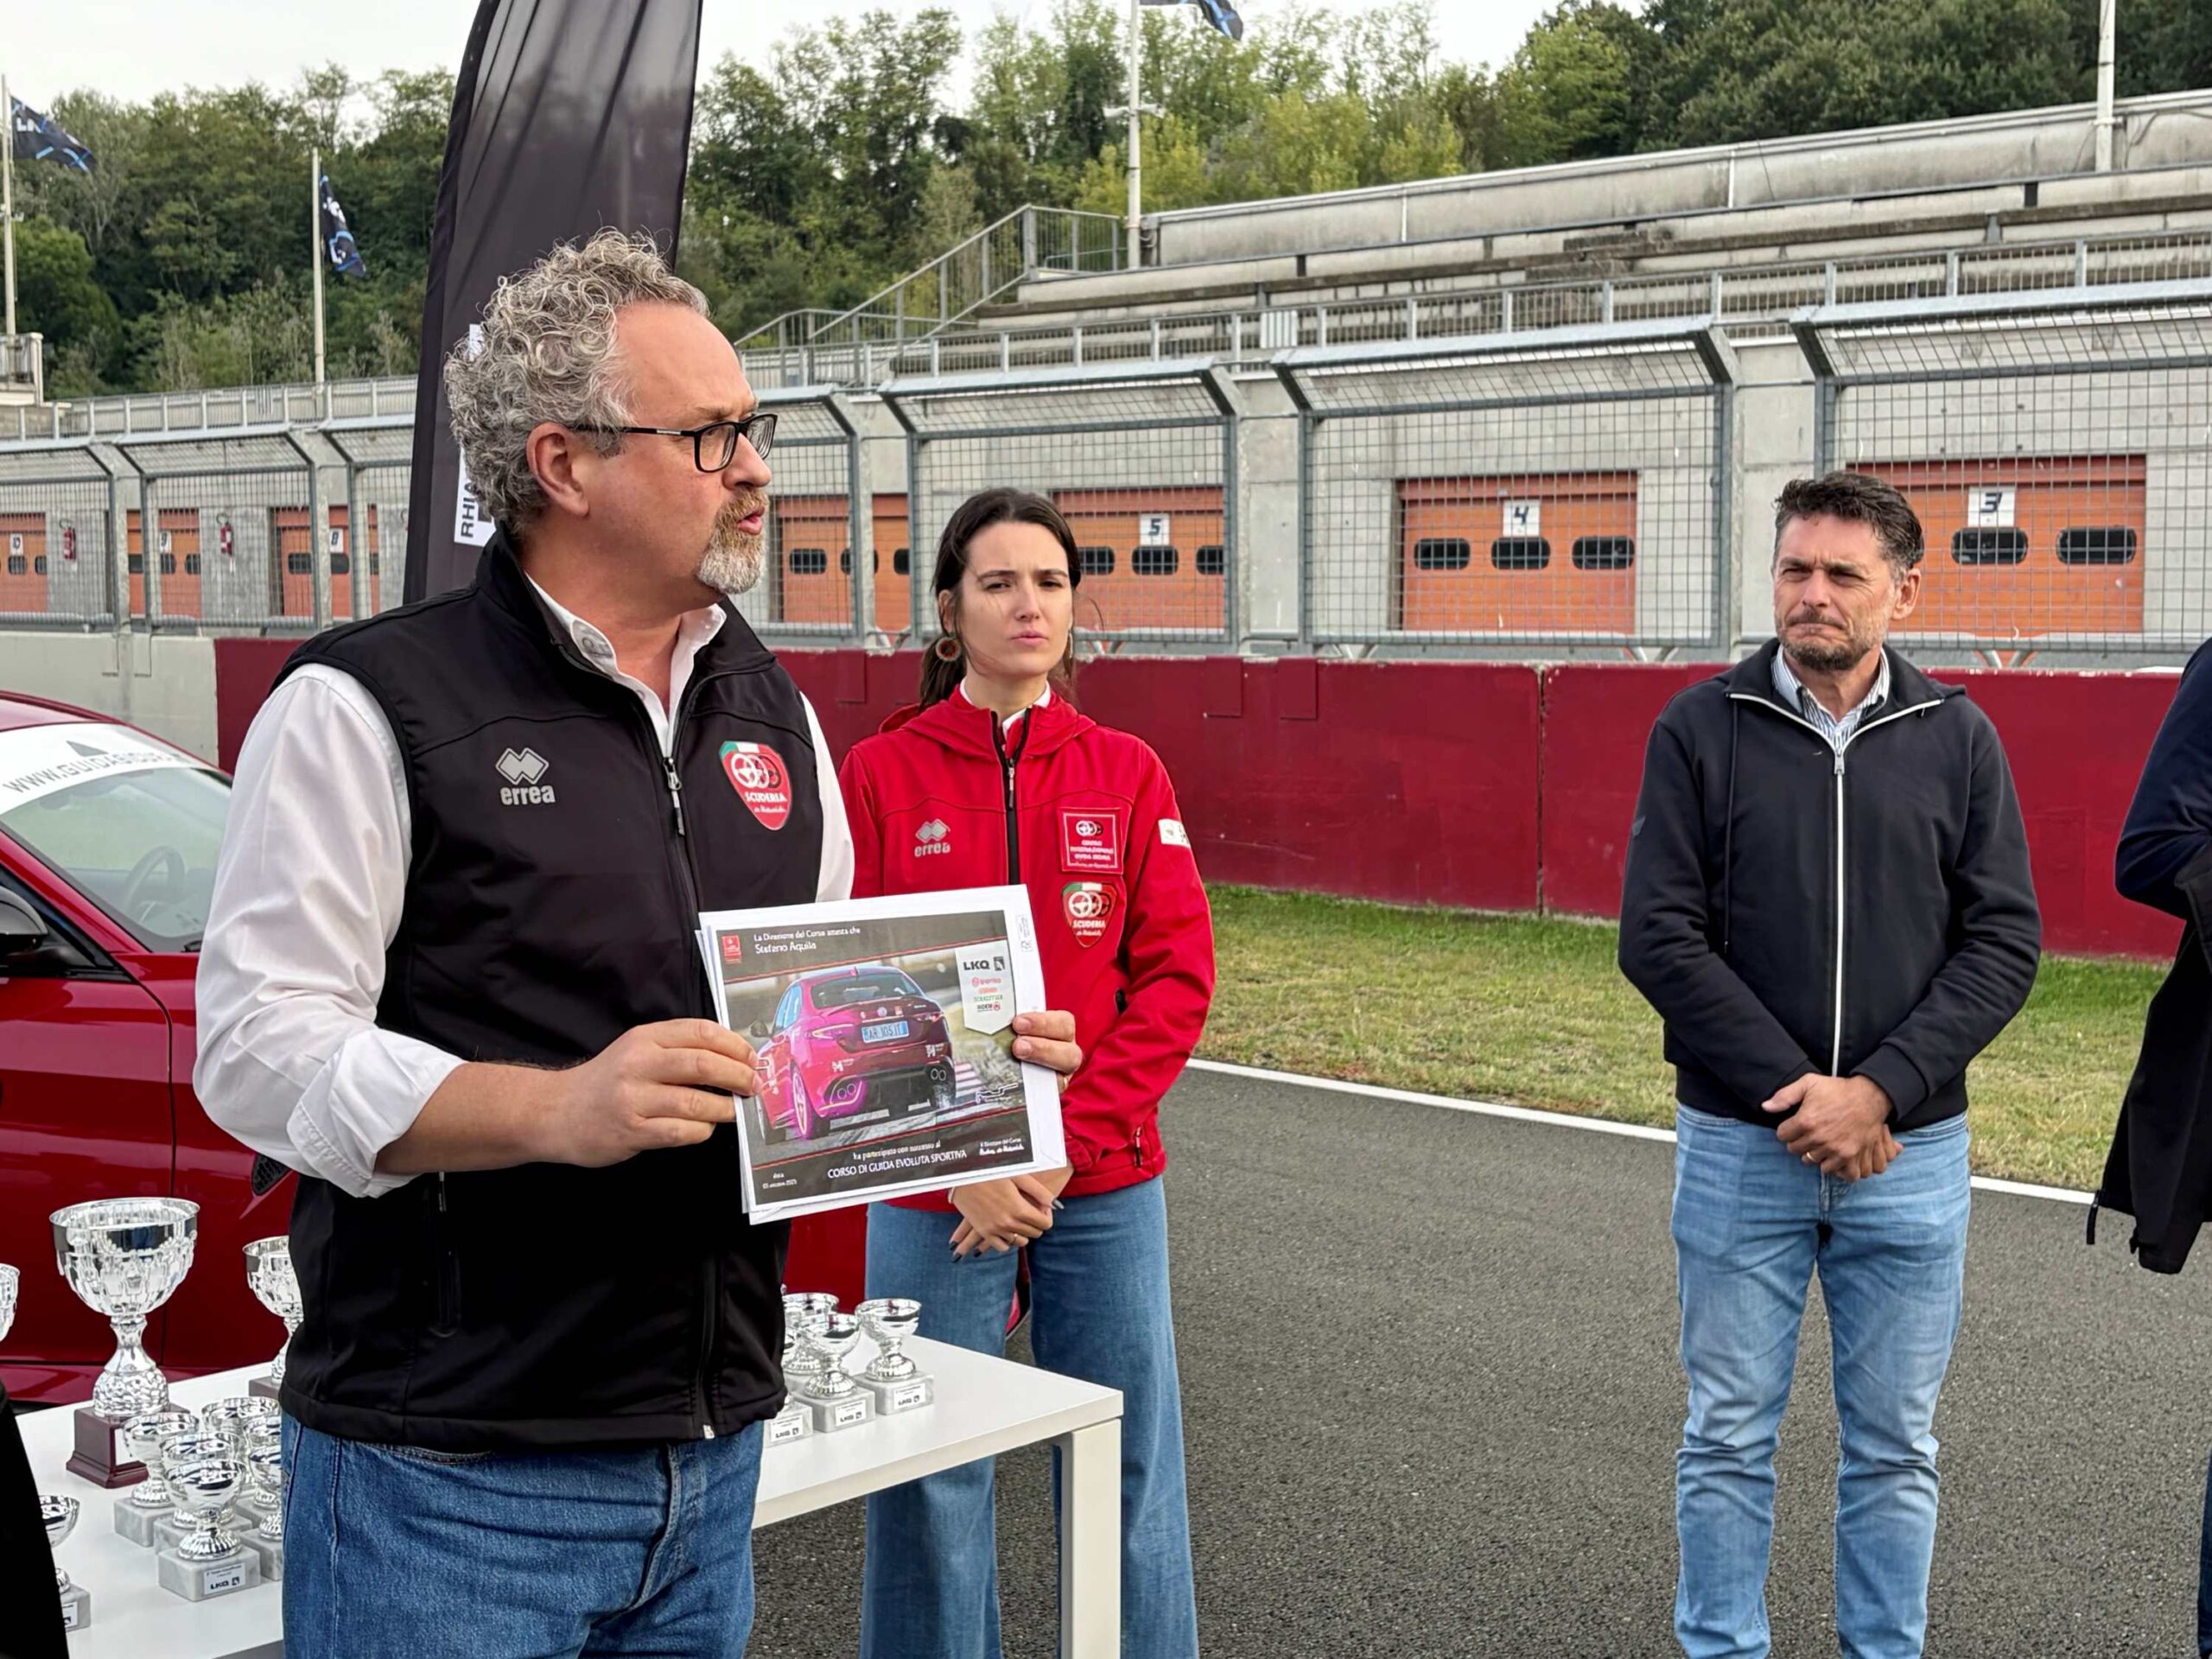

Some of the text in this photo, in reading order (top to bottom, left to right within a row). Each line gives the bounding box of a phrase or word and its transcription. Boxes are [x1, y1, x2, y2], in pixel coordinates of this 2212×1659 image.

[461, 482, 475, 537] RHIA
[1980, 493, 2002, 512] 3
[1514, 506, 1529, 525] 4
[1148, 518, 1160, 536] 5
[500, 785, 556, 805] errea
[790, 941, 817, 952] Aquila
[963, 960, 990, 970] LKQ
[827, 1166, 857, 1179] CORSO
[858, 1164, 868, 1174] DI
[868, 1160, 894, 1173] GUIDA
[895, 1156, 931, 1168] EVOLUTA
[931, 1149, 967, 1163] SPORTIVA
